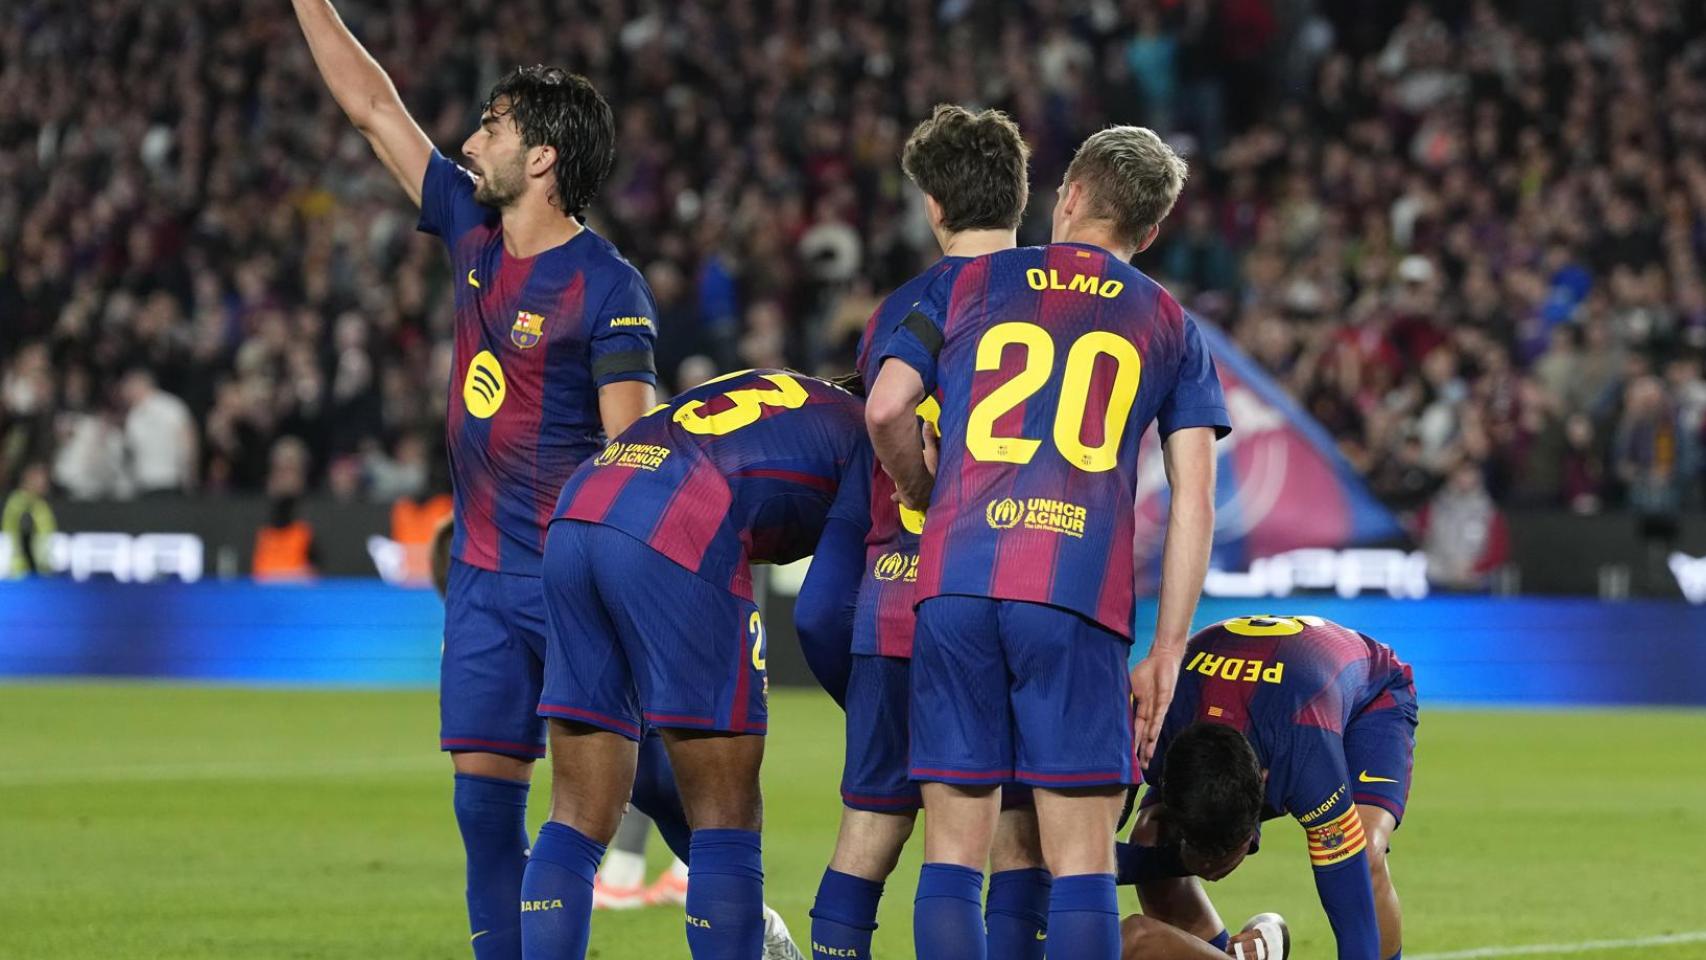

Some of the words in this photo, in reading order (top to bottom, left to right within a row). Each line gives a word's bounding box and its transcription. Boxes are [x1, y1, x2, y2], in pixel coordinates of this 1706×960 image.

[1026, 268, 1124, 299] OLMO
[642, 369, 810, 436] 3
[965, 321, 1142, 473] 20
[618, 452, 664, 468] ACNUR
[626, 443, 671, 459] UNHCR
[1024, 511, 1085, 533] ACNUR
[1027, 498, 1086, 520] UNHCR
[1186, 651, 1285, 684] PEDRI
